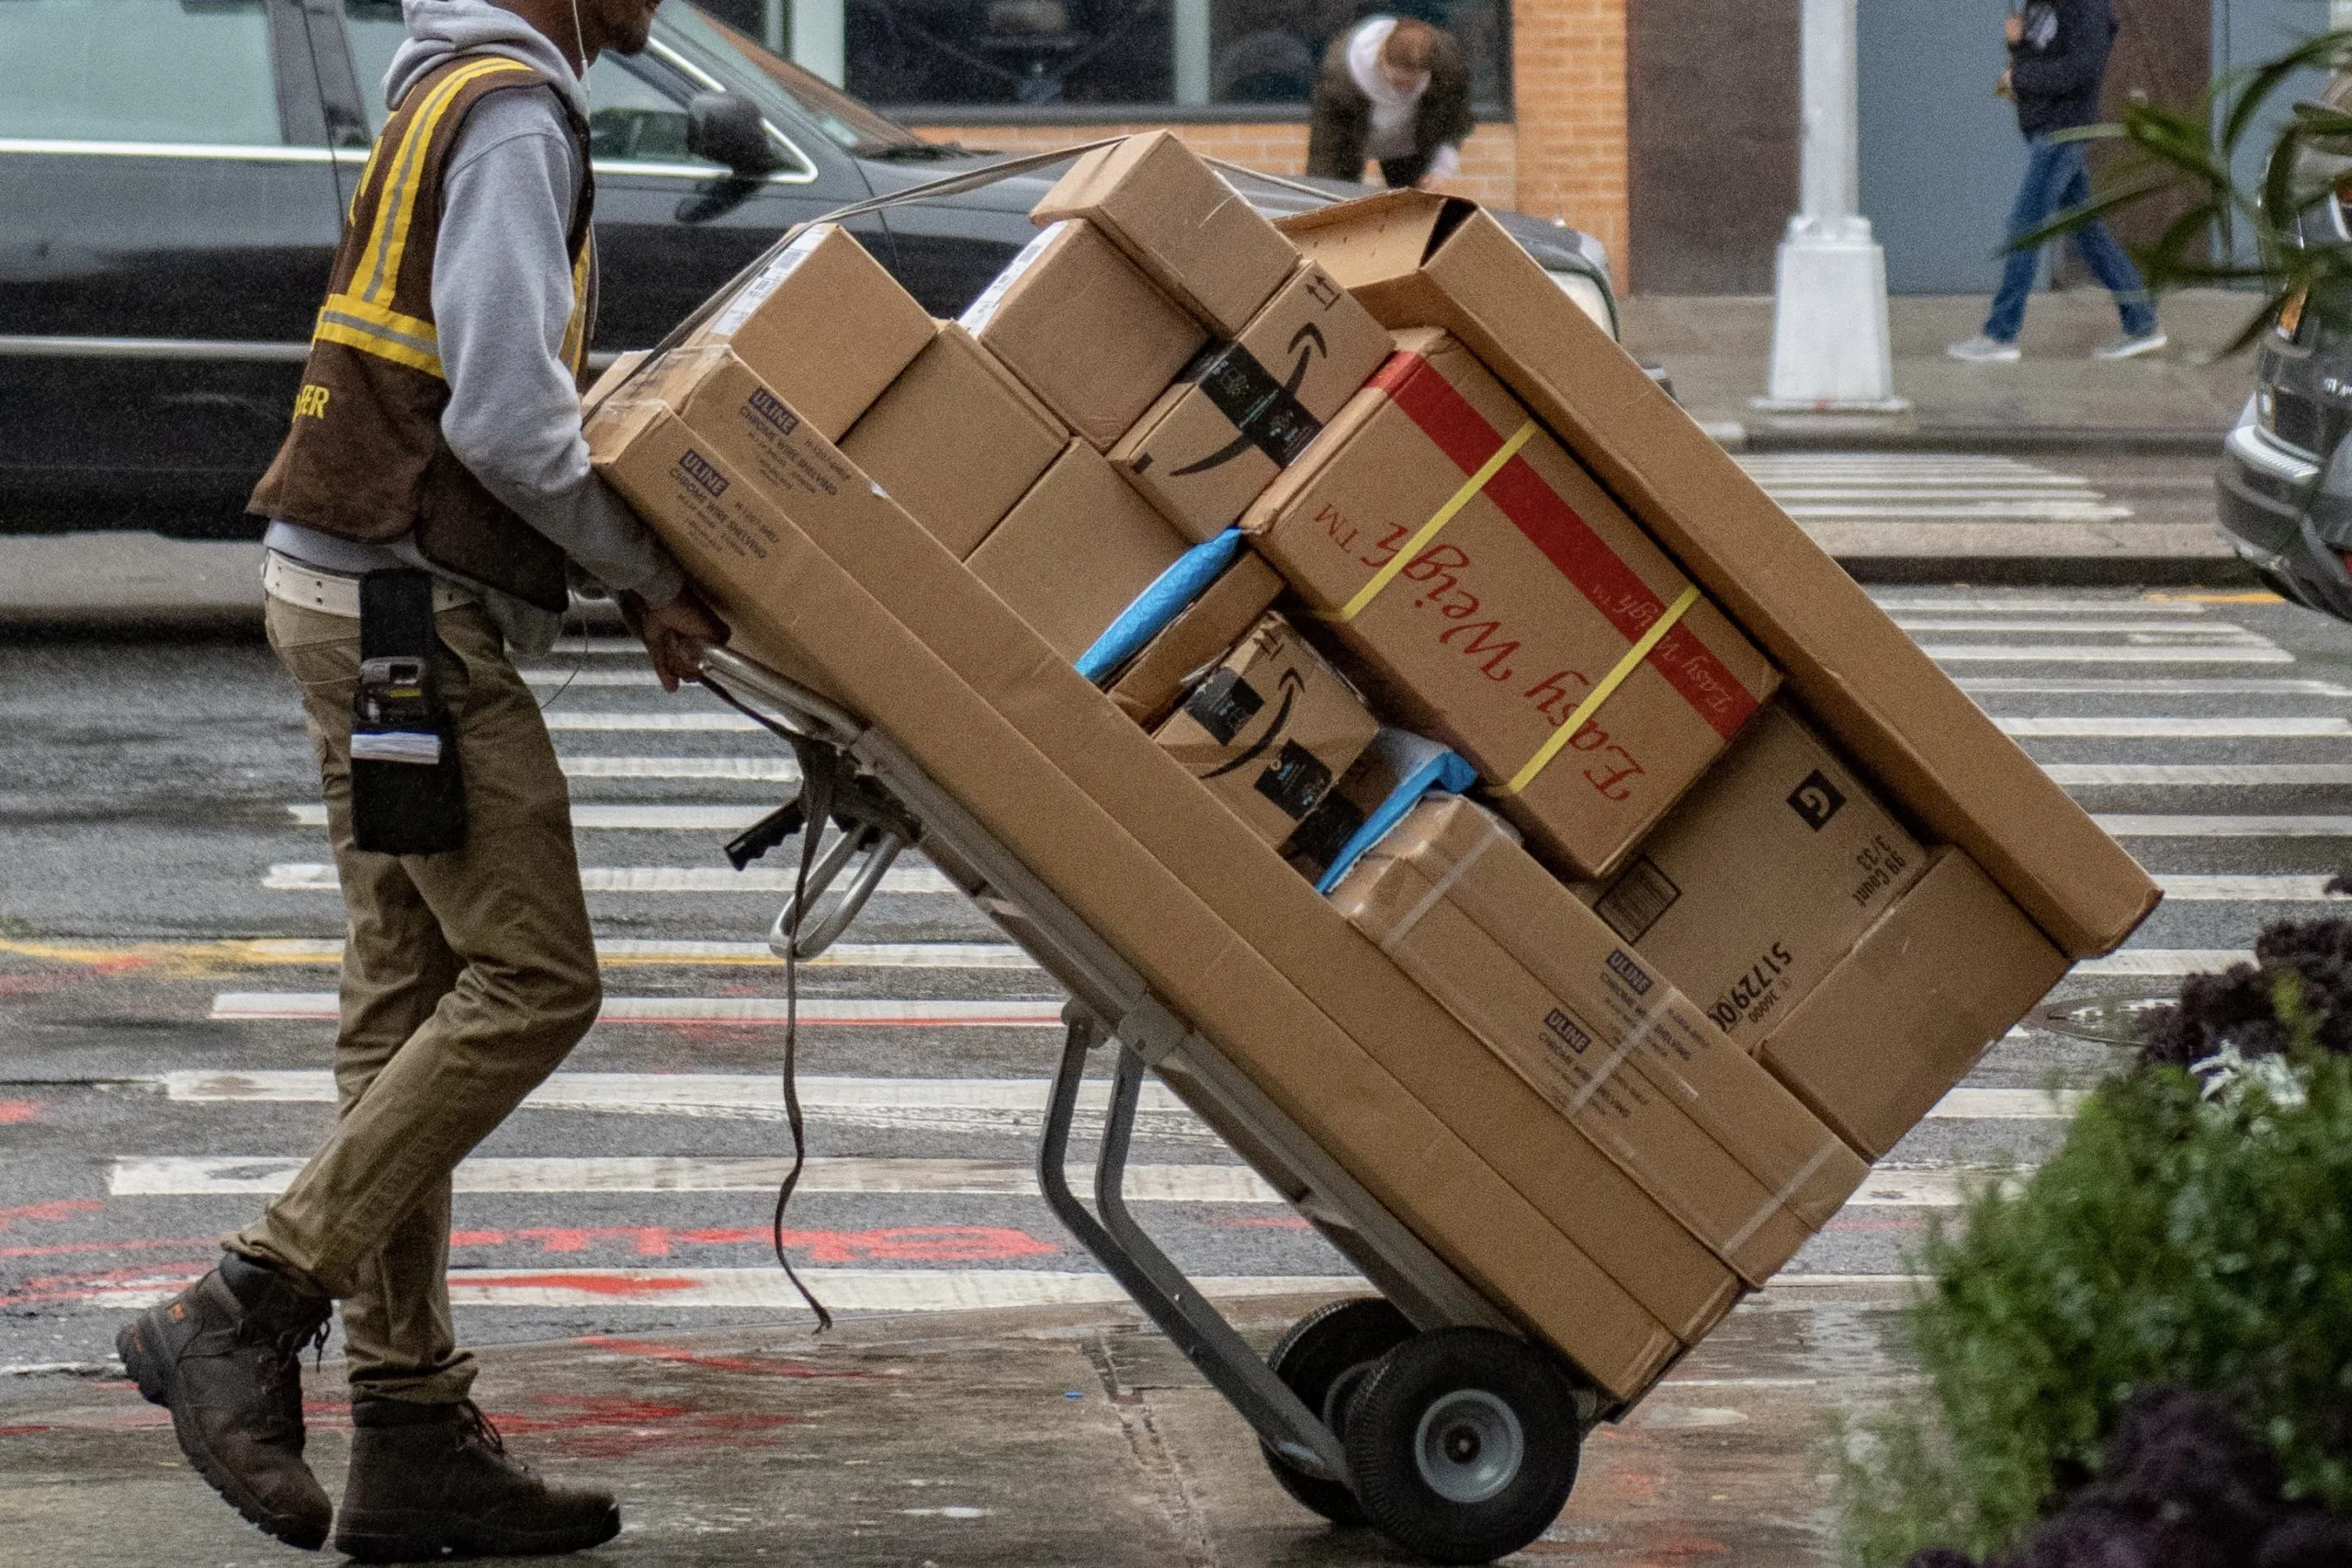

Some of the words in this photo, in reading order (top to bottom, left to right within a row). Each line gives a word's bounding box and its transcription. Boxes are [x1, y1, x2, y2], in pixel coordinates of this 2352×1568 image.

[750, 388, 797, 434] ULINE
[679, 450, 728, 496] ULINE
[740, 405, 776, 443] CHROME
[775, 439, 798, 462] WIRE
[796, 457, 839, 496] SHELVING
[671, 467, 707, 504] CHROME
[705, 502, 728, 525] WIRE
[725, 520, 768, 560] SHELVING
[1360, 522, 1521, 679] Weigh
[1612, 592, 1679, 661] Wigh
[1681, 657, 1733, 713] Easy
[1523, 671, 1646, 801] Easy
[1850, 866, 1892, 908] Count
[1883, 850, 1907, 874] 99
[1606, 950, 1653, 995] ULINE
[1545, 1010, 1591, 1053] ULINE
